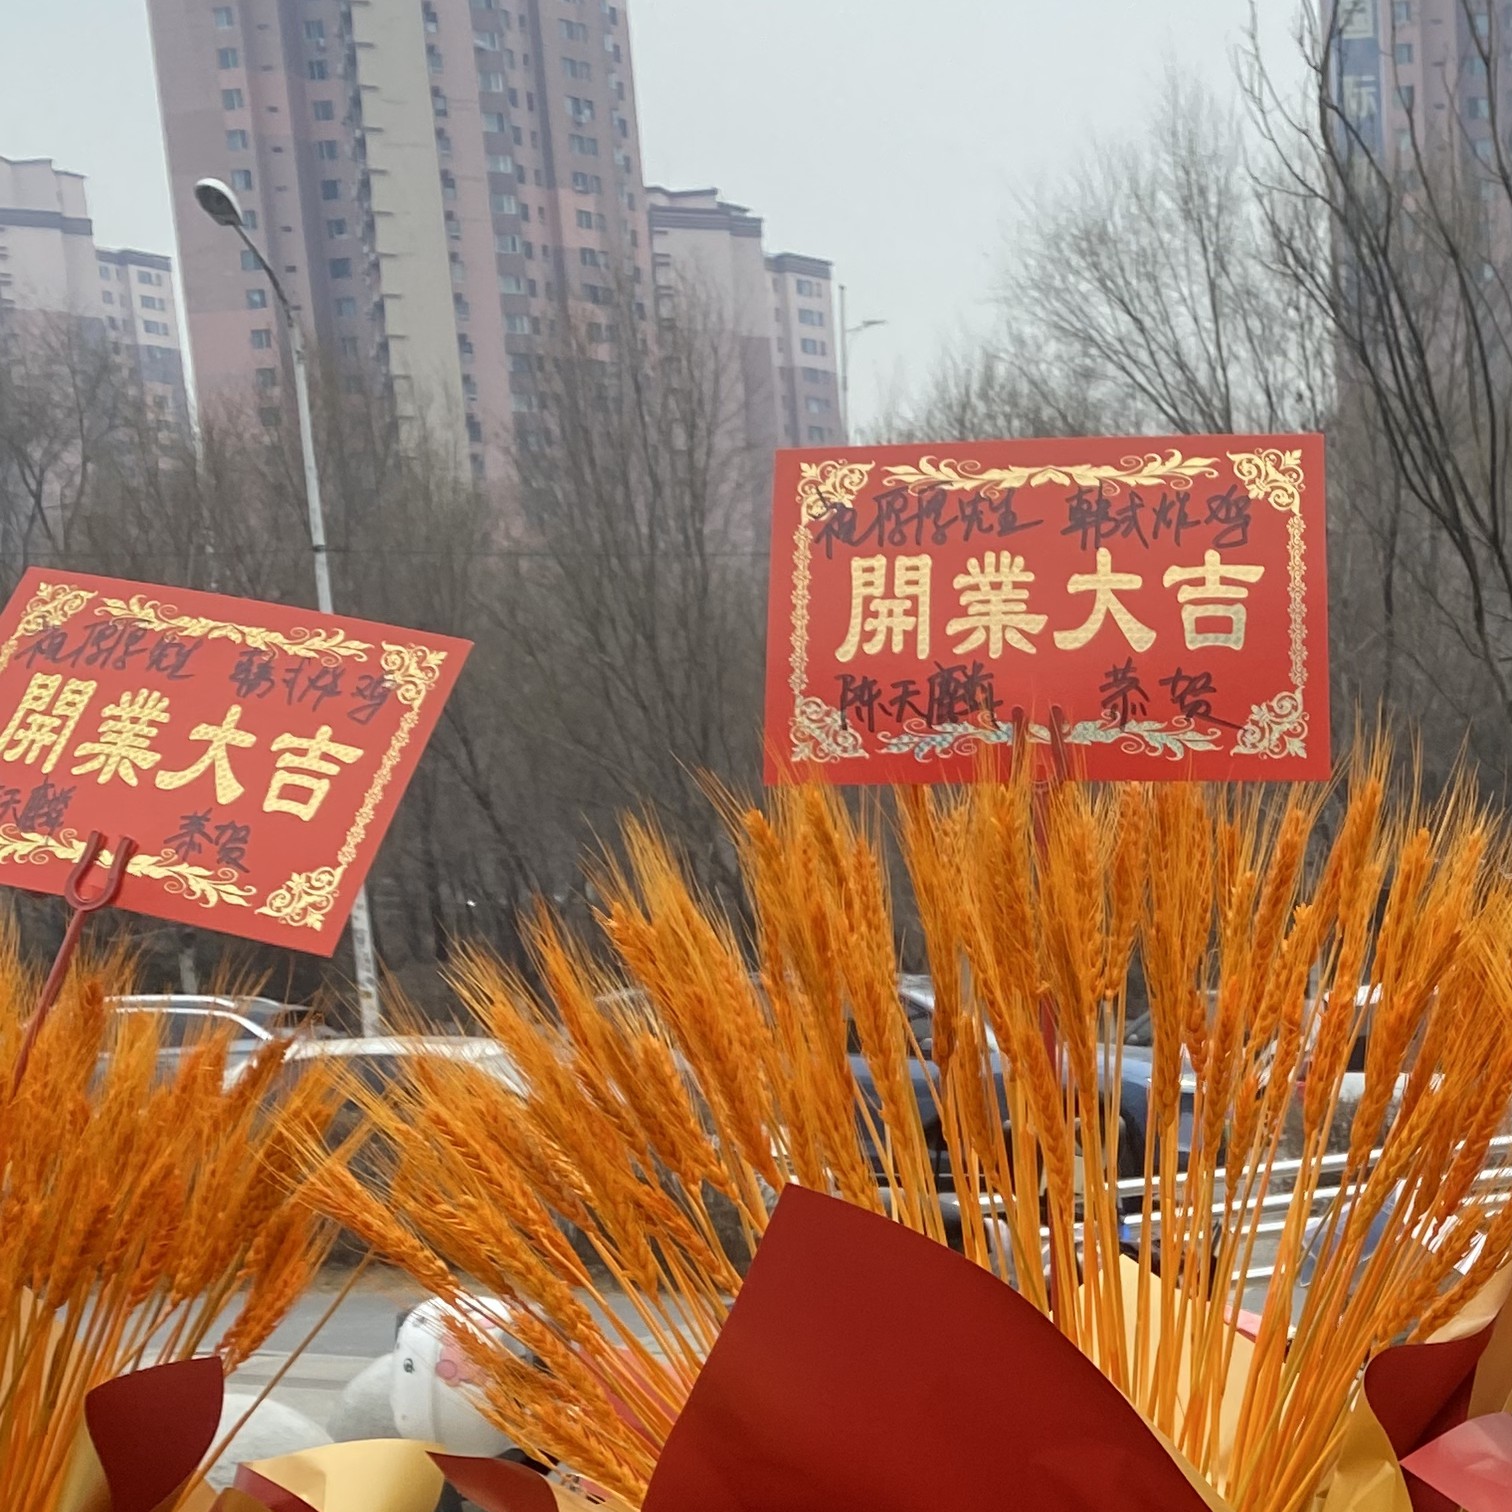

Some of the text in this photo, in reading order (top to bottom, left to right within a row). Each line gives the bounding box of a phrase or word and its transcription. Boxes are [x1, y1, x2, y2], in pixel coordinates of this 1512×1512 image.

[834, 547, 1266, 663] 開業大吉
[1, 671, 365, 822] 開業大吉
